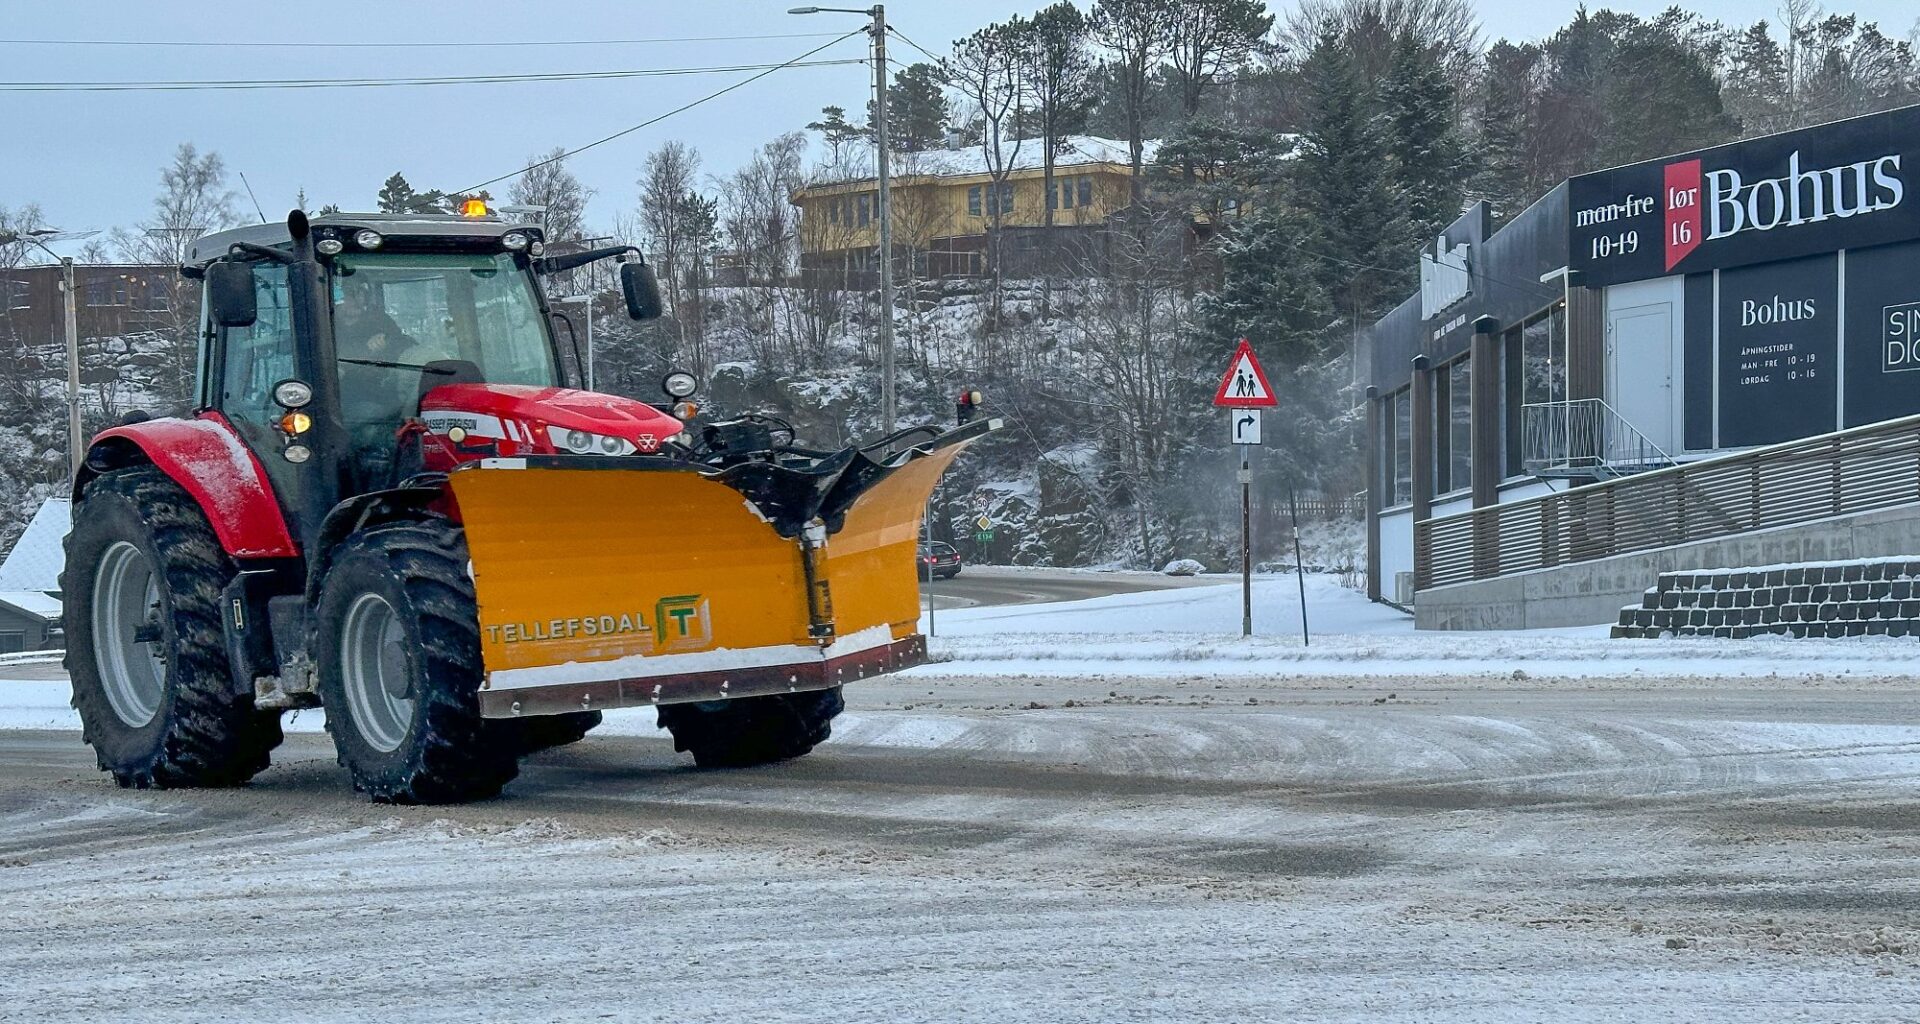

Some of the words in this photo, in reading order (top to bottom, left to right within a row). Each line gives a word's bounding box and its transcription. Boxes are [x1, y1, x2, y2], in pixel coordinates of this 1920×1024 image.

[1668, 186, 1697, 210] lør
[1705, 150, 1904, 240] Bohus
[1576, 193, 1654, 227] man-fre
[1591, 230, 1639, 259] 10-19
[1671, 221, 1692, 246] 16
[1741, 294, 1815, 327] Bohus
[1741, 343, 1793, 356] ÅPNINGSTIDER
[1741, 361, 1758, 370] MAN
[1765, 359, 1778, 368] FRE
[1787, 355, 1796, 365] 10
[1806, 353, 1815, 363] 19
[1741, 374, 1769, 385] LØRDAG
[1787, 370, 1796, 380] 10
[1806, 368, 1815, 378] 16
[487, 612, 651, 643] TELLEFSDAL
